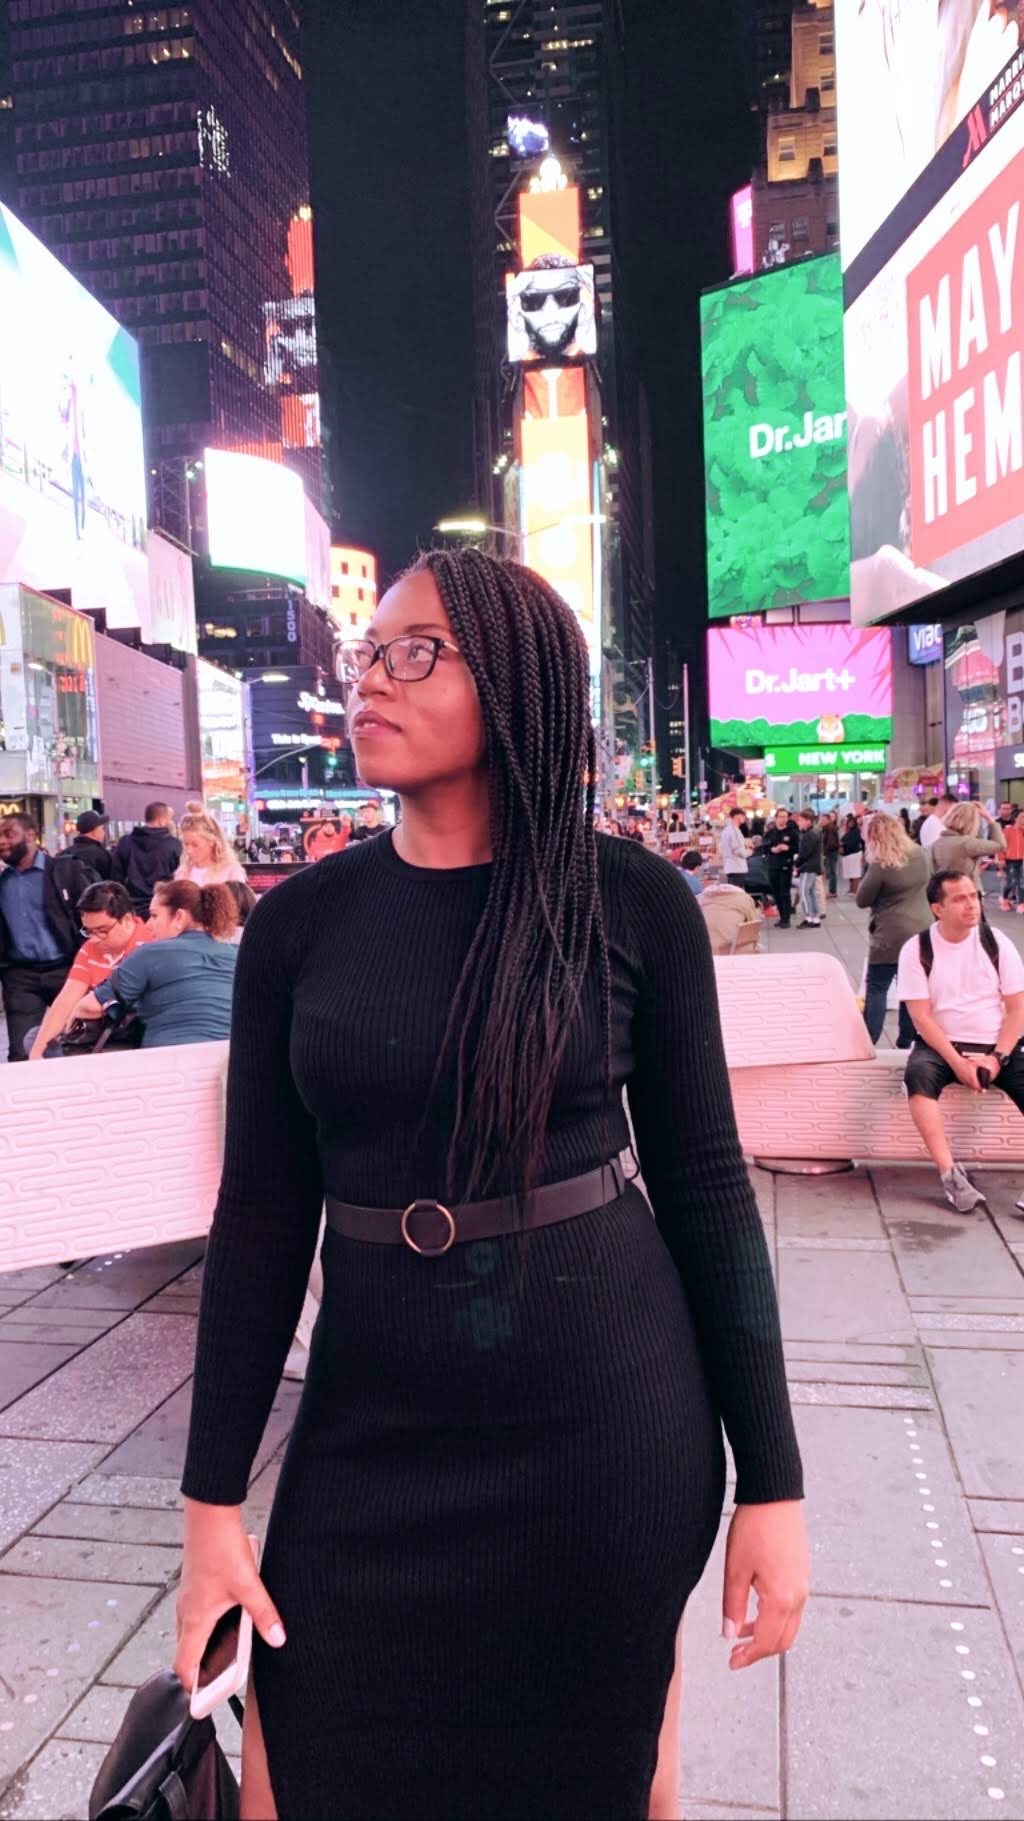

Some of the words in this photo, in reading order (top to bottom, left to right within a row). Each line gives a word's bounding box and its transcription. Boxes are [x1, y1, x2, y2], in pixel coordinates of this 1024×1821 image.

[920, 200, 1021, 401] MAY
[923, 351, 1024, 525] HEM
[287, 599, 297, 642] 1500
[745, 667, 856, 694] Dr.Jart+
[798, 752, 837, 766] NEW
[841, 750, 885, 764] YORK
